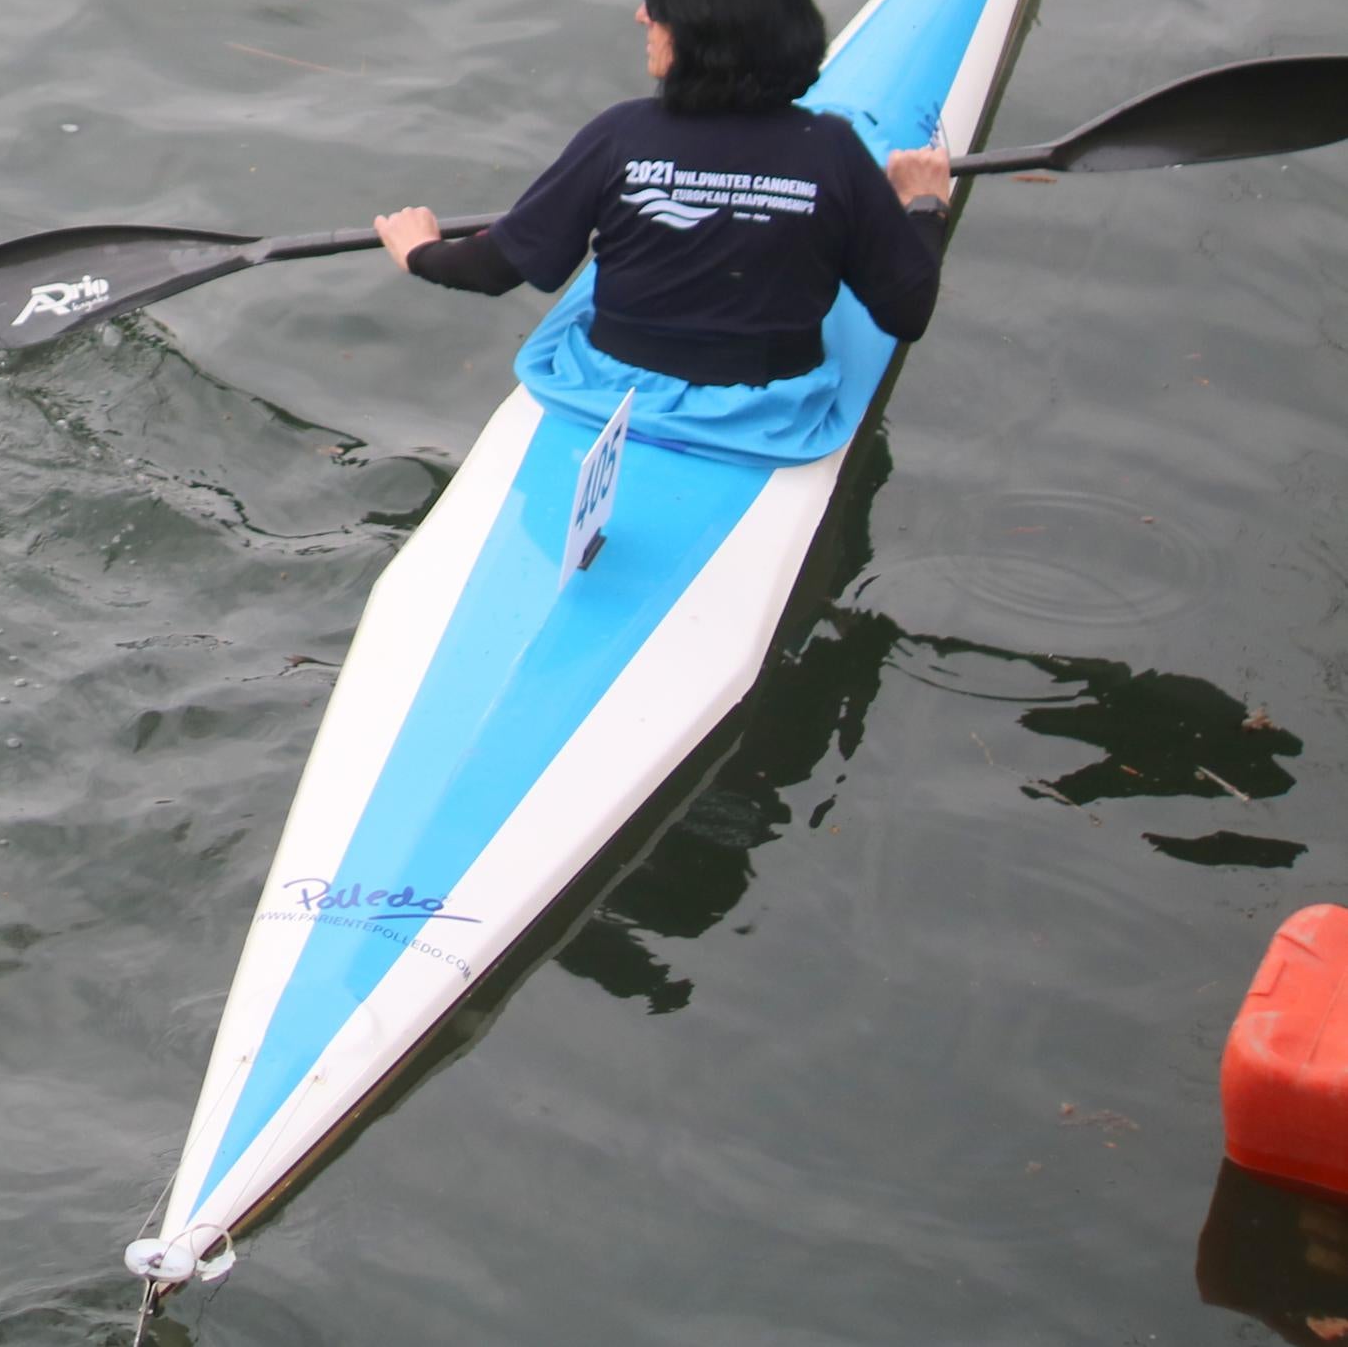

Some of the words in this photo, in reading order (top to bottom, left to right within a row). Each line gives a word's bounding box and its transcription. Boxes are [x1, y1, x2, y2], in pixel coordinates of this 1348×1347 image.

[624, 160, 675, 185] 2021
[674, 170, 752, 190] WILDWATER
[752, 175, 817, 198] CANOEING
[671, 188, 730, 206] EUROPEAN
[730, 192, 815, 214] CHAMPIONSHIPS
